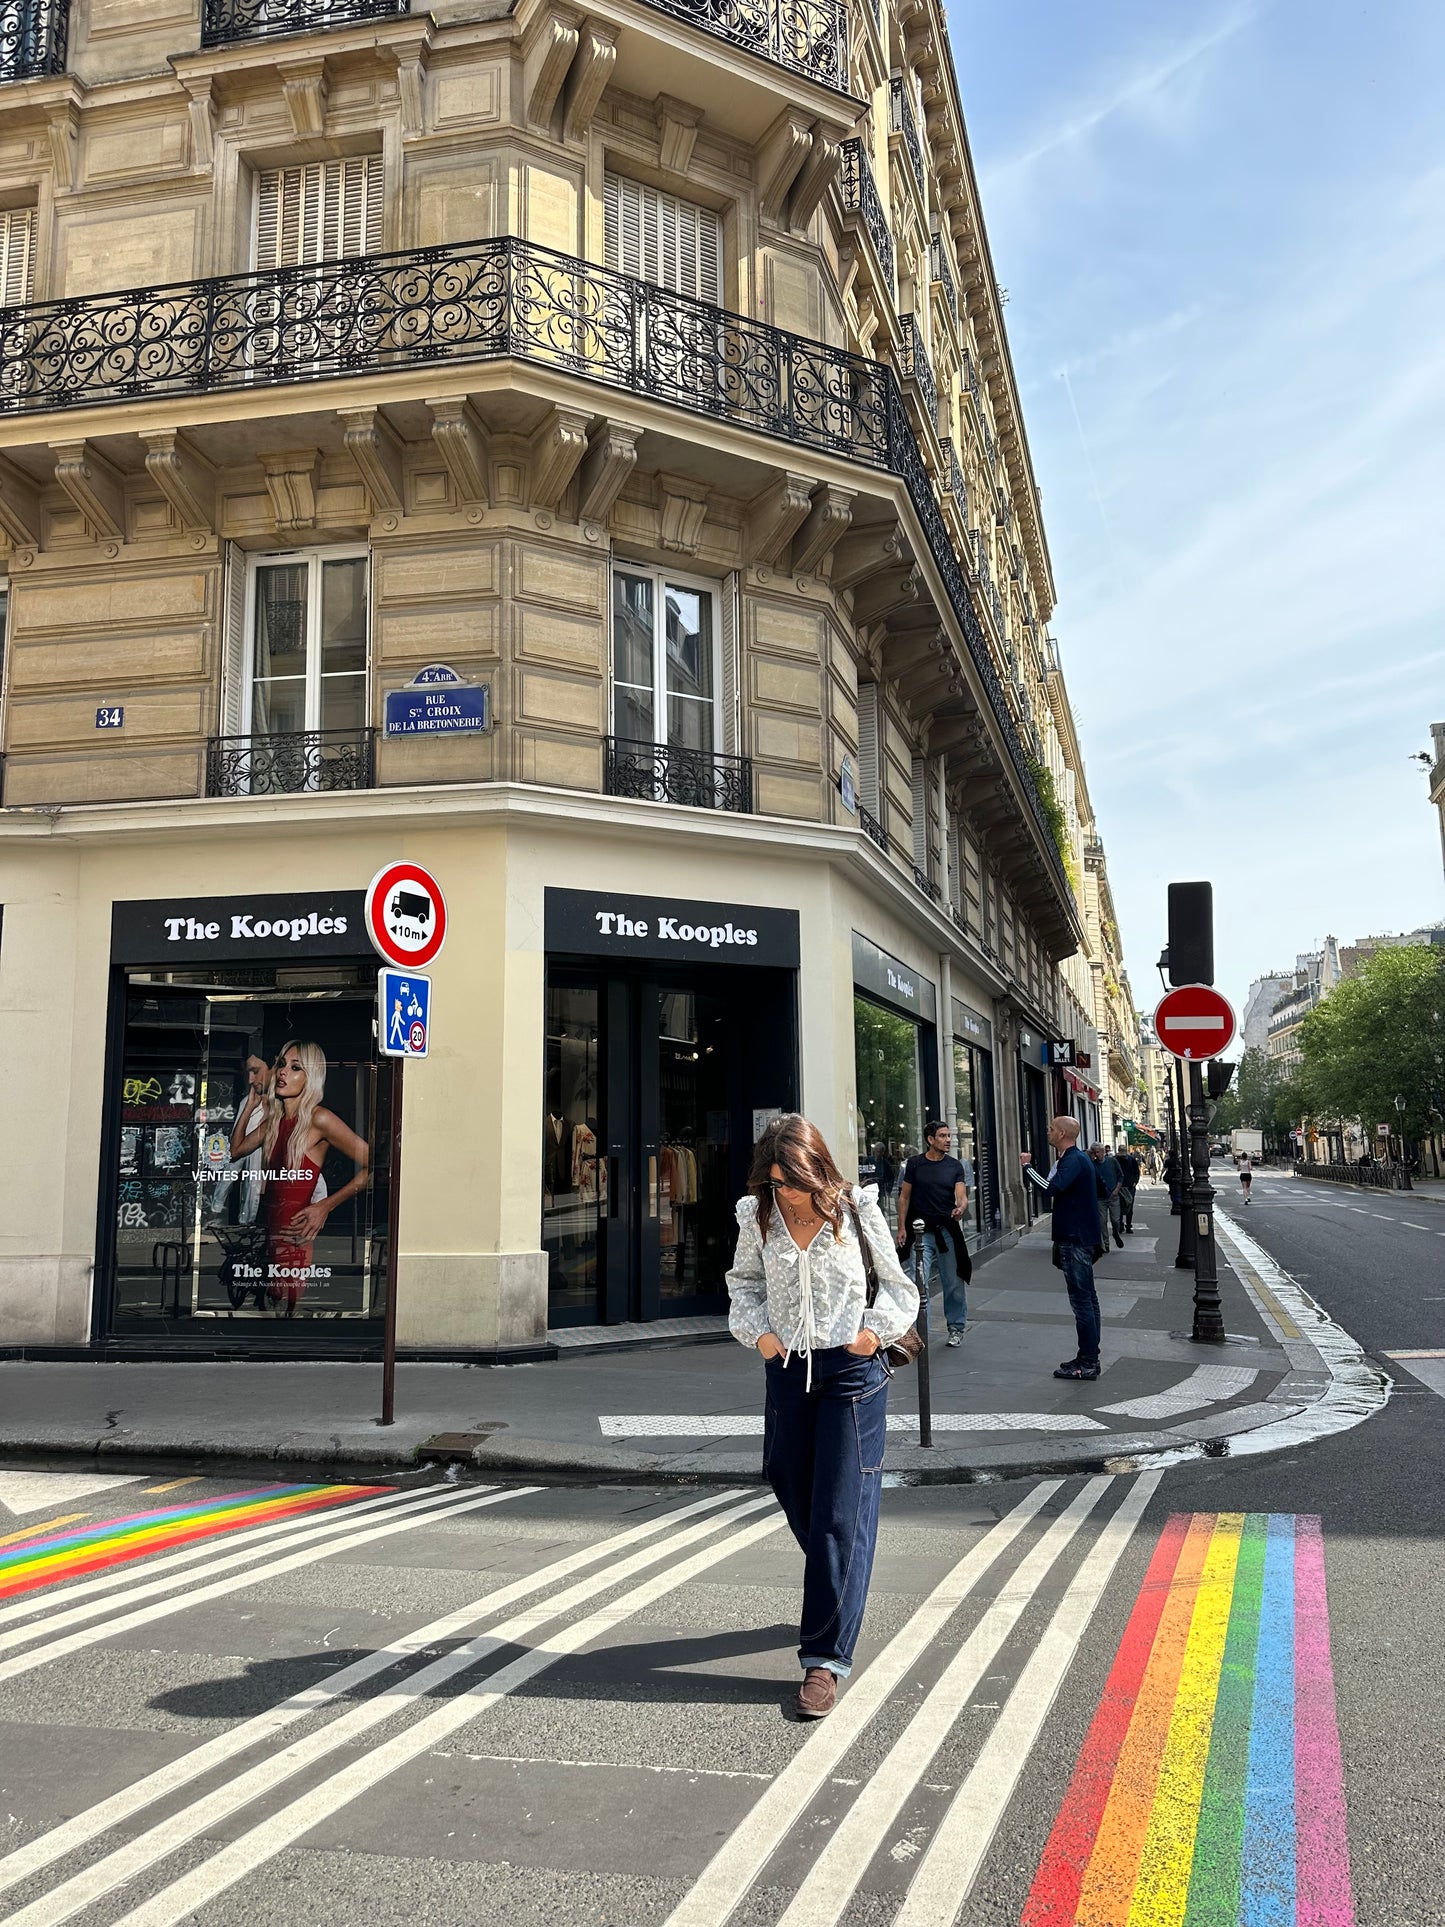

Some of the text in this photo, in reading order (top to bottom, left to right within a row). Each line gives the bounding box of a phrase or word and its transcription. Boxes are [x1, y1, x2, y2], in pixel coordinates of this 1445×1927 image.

[425, 695, 446, 705] RUE
[98, 708, 121, 727] 34
[427, 705, 462, 717] CROIX
[389, 717, 482, 732] DE LA BRETONNERIE
[164, 912, 348, 942] The Kooples
[595, 911, 758, 948] The Kooples
[887, 968, 914, 998] The Kooples
[412, 1031, 423, 1042] 20
[191, 1167, 313, 1182] VENTES PRIVILÈGES
[231, 1264, 332, 1280] The Kooples
